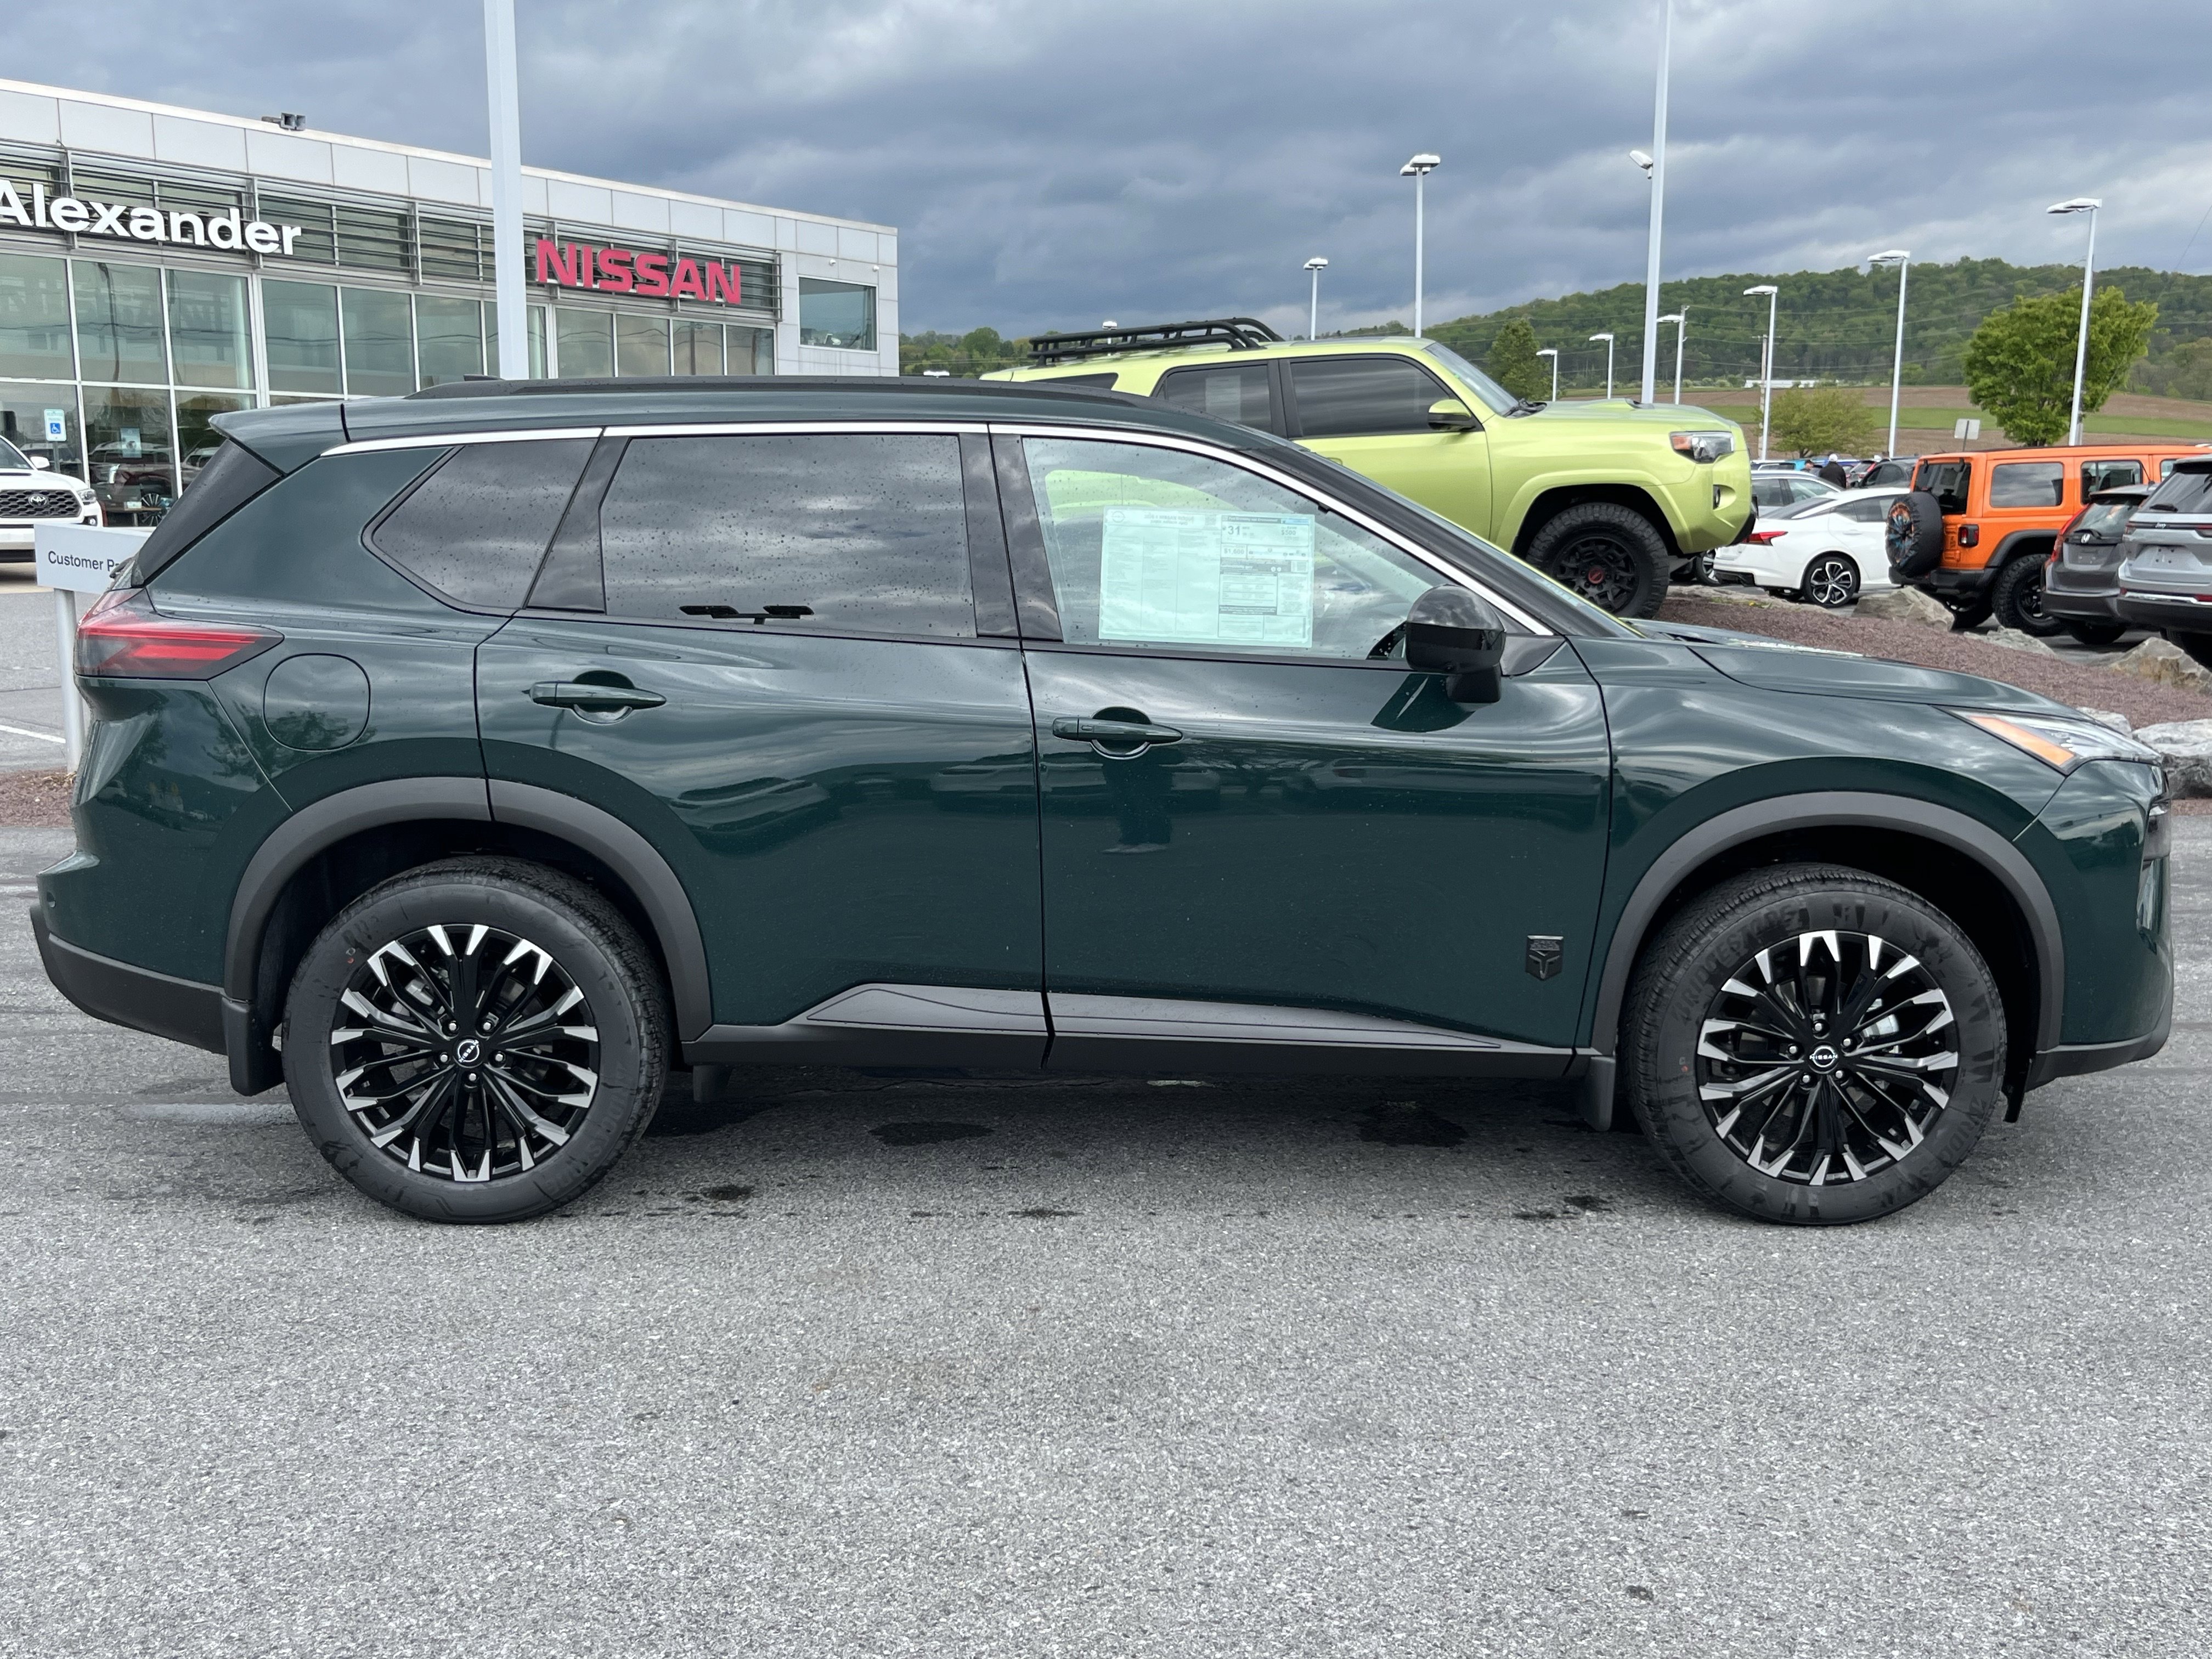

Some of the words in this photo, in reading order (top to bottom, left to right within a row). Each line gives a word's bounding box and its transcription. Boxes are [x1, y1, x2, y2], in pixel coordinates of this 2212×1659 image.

[0, 179, 302, 256] Alexander
[536, 239, 741, 305] NISSAN
[1228, 525, 1240, 535] 31
[48, 550, 104, 571] Customer
[107, 558, 120, 572] P
[459, 1039, 479, 1063] NISSAN
